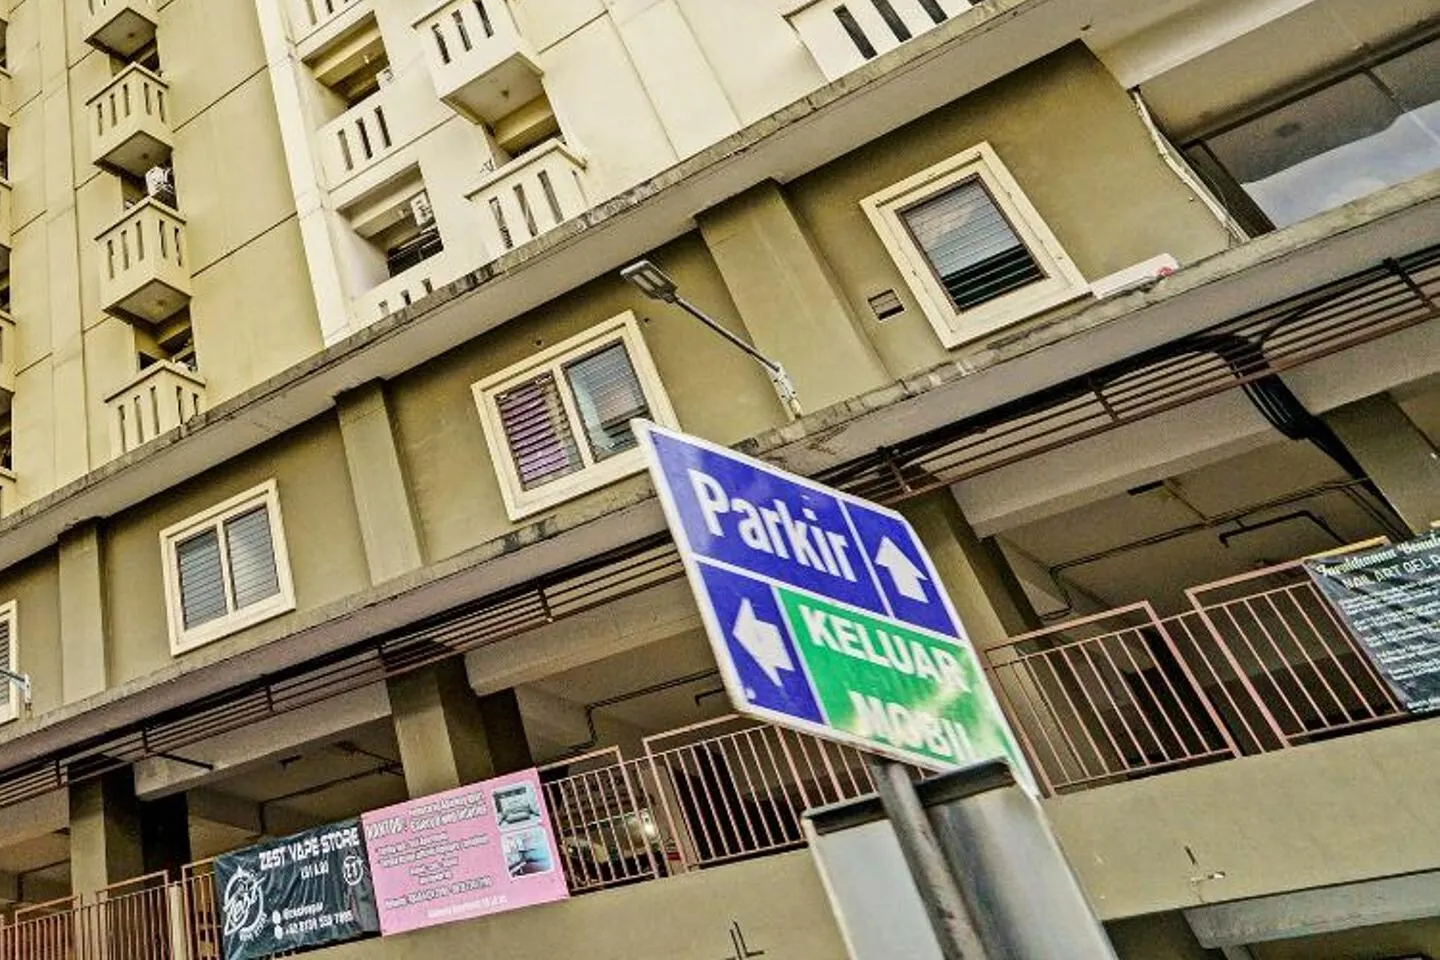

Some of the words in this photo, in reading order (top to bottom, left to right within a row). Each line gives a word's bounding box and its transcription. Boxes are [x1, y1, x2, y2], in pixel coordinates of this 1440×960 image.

[687, 467, 858, 582] Parkir
[1374, 563, 1402, 583] ART
[797, 604, 972, 694] KELUAR
[259, 846, 286, 871] ZEST
[287, 837, 320, 862] VAPE
[321, 827, 360, 854] STORE
